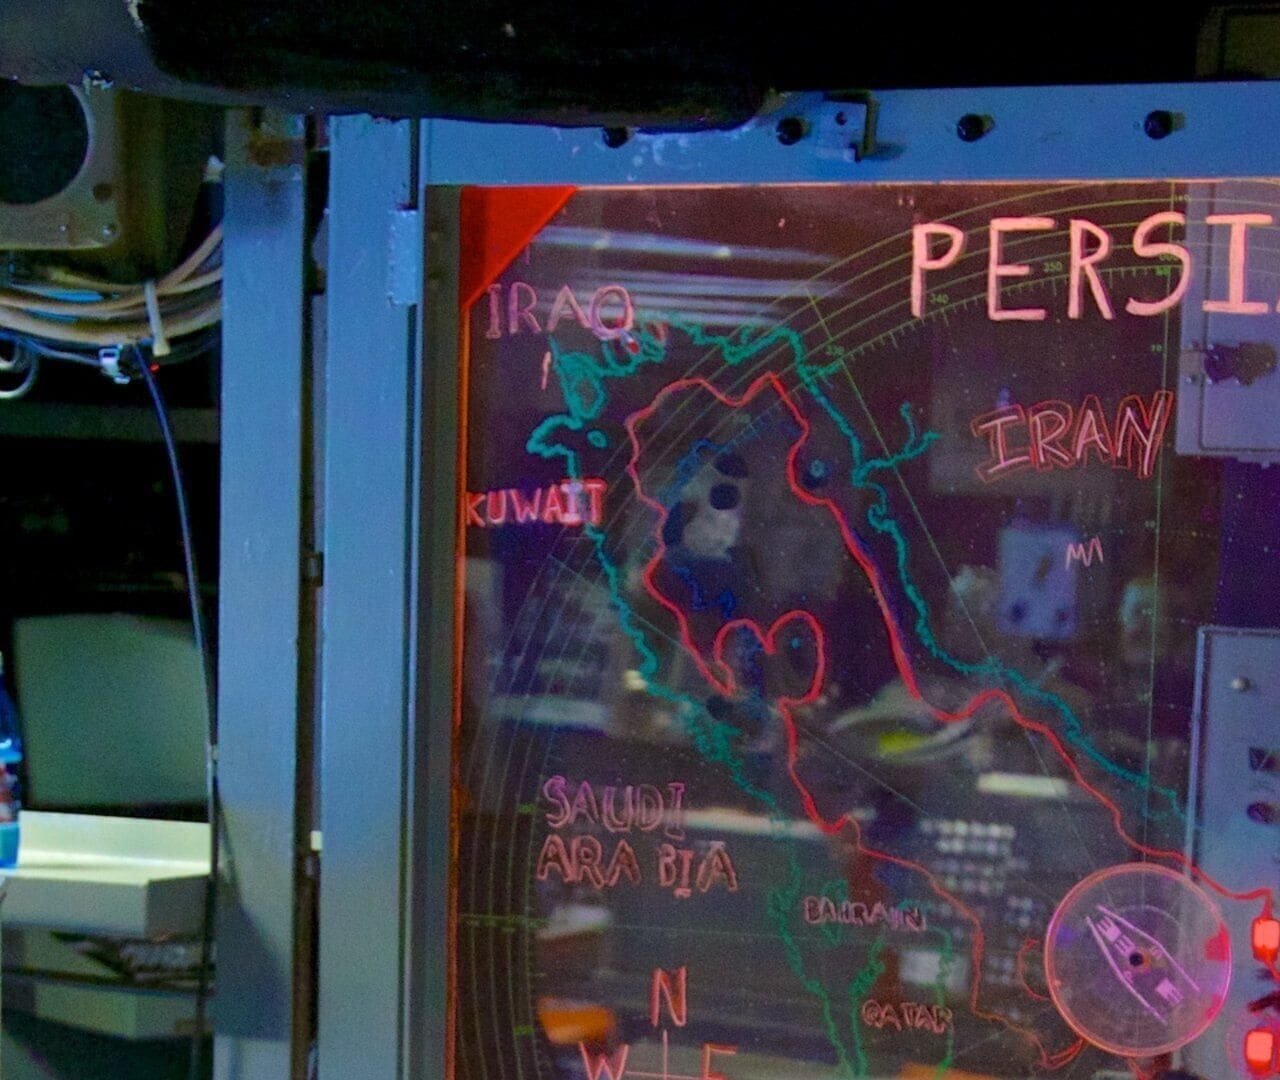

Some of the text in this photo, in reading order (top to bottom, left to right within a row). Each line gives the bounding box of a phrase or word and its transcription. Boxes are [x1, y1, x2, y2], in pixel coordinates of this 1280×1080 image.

[485, 282, 637, 348] IRAQ
[971, 391, 1174, 483] IRAN
[466, 477, 607, 528] KUWAIT
[544, 775, 687, 840] SAUDI
[650, 964, 688, 1029] N
